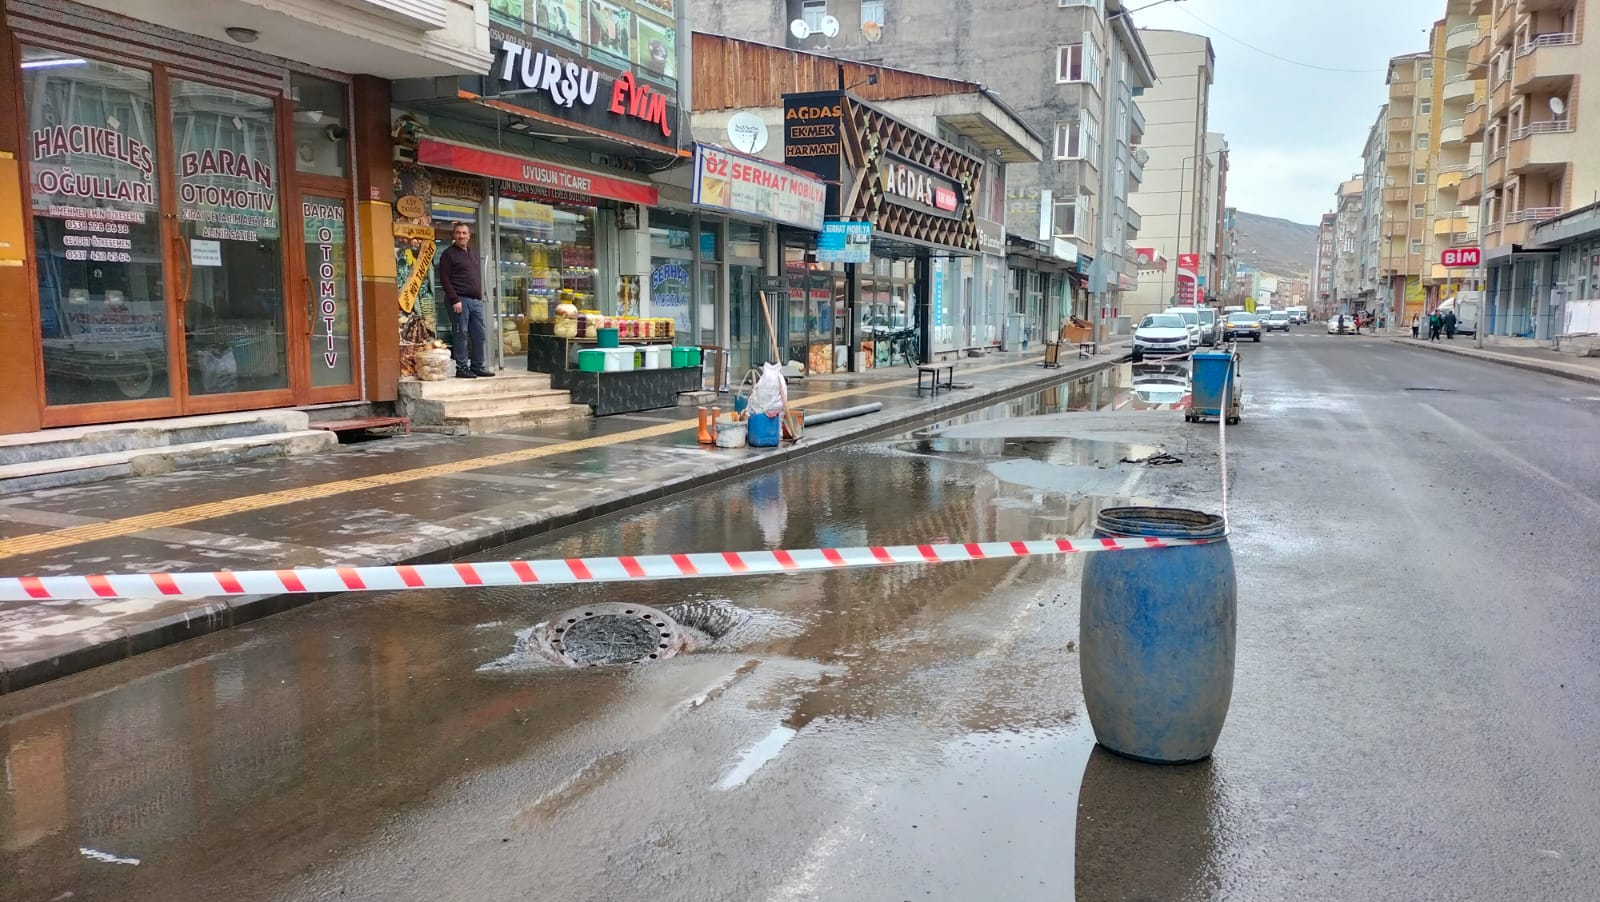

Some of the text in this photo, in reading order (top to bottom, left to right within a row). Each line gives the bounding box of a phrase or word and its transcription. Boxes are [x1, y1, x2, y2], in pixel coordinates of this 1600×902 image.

[502, 40, 672, 137] TURŞU EVİM
[791, 124, 835, 139] EKMEK
[33, 124, 153, 180] HACIKELEŞ
[786, 143, 839, 157] HARMANI
[181, 148, 272, 190] BARAN
[523, 165, 592, 191] UYUSUN TİCARET
[706, 151, 824, 204] ÖZ SERHAT MOBİLYA
[39, 166, 154, 204] OĞULLARI
[181, 182, 275, 212] OTOMOTİV
[65, 219, 88, 230] 0538
[303, 203, 344, 221] BARAN
[1444, 249, 1477, 264] BİM
[652, 264, 689, 290] SERHAT
[318, 227, 337, 369] OTOMOTİV
